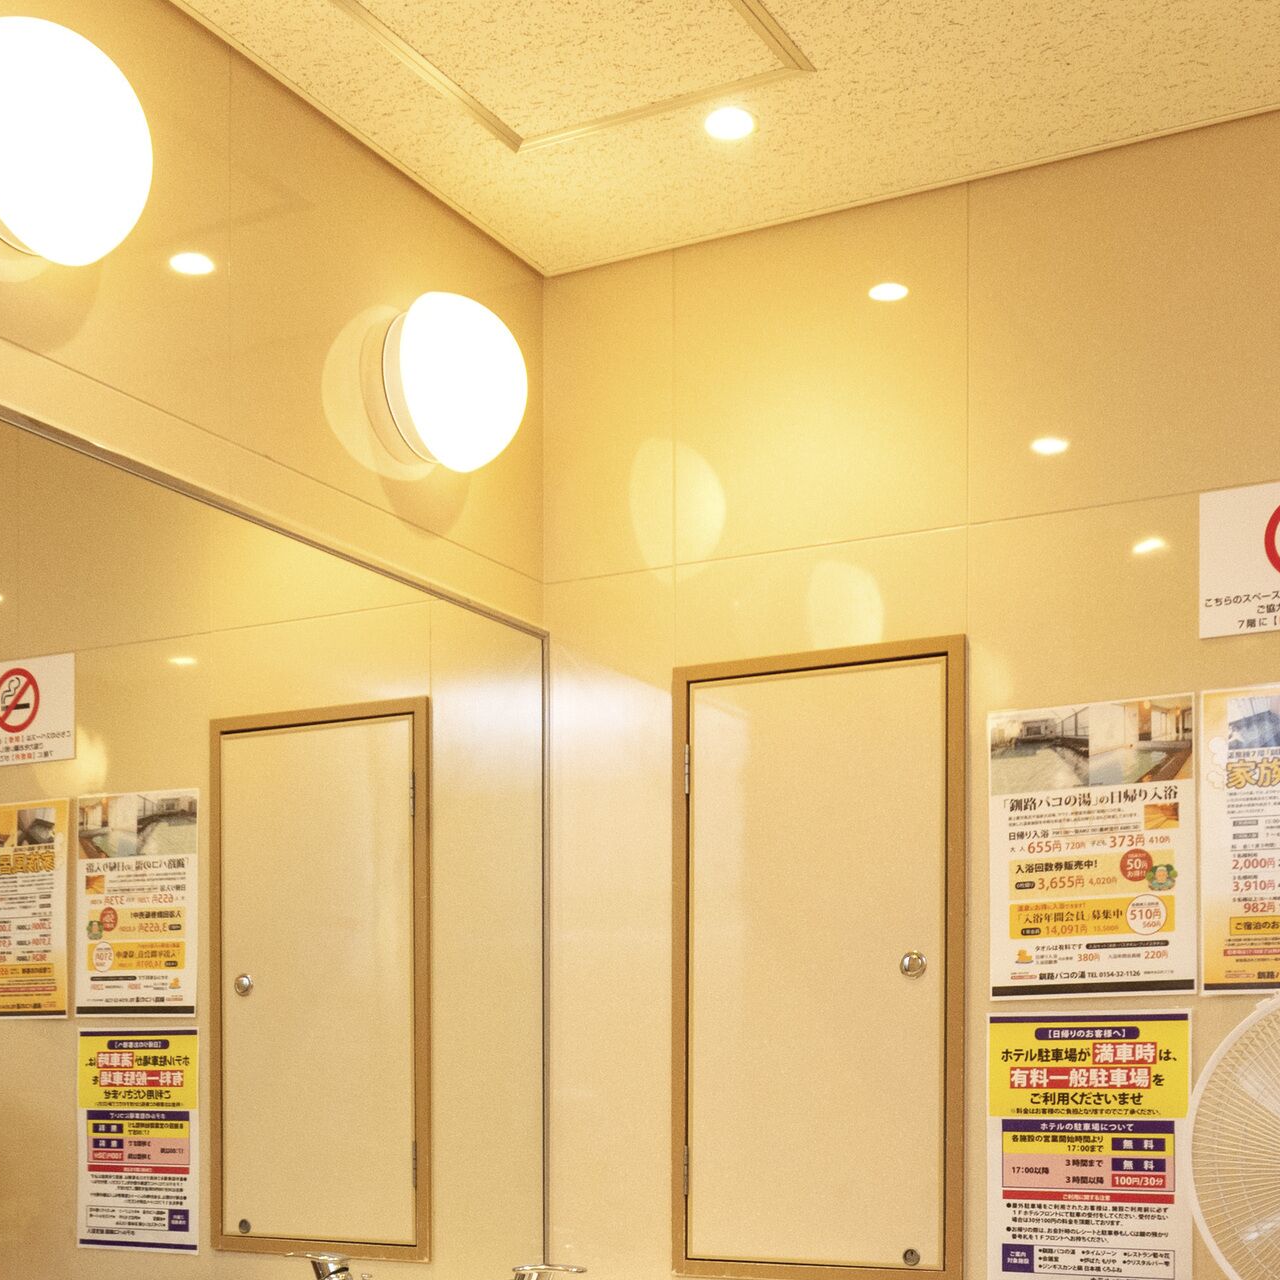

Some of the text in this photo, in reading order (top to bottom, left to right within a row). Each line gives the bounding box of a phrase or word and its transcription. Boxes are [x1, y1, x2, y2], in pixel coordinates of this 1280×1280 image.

[1002, 786, 1179, 812] 「釧路パコの湯」の日帰り入浴
[1009, 830, 1049, 841] 日帰り入浴
[1027, 840, 1062, 854] 655円
[1109, 834, 1145, 848] 373円
[1148, 836, 1170, 844] 410円
[1015, 860, 1098, 874] 入浴回数券販売中!
[1126, 859, 1148, 870] 50円
[1232, 858, 1276, 870] 2,000円
[1038, 876, 1085, 890] 3,655円
[1088, 877, 1118, 886] 4,020円
[1233, 879, 1276, 892] 3,910円
[1243, 901, 1276, 913] 982円
[1130, 908, 1161, 920] 510円
[1045, 924, 1087, 935] 14,091円
[1035, 942, 1083, 952] タオルは有料です
[1077, 953, 1100, 962] 380円
[1144, 950, 1169, 960] 220円
[1039, 970, 1086, 980] 釧路パコの湯
[1099, 970, 1140, 978] 0154-32-1126
[1048, 1028, 1127, 1038] 【日帰りのお客様へ】
[1030, 1092, 1144, 1105] ご利用くださいませ
[1040, 1122, 1134, 1132] ホテルの駐車場について
[1114, 1176, 1164, 1186] 100円/30分
